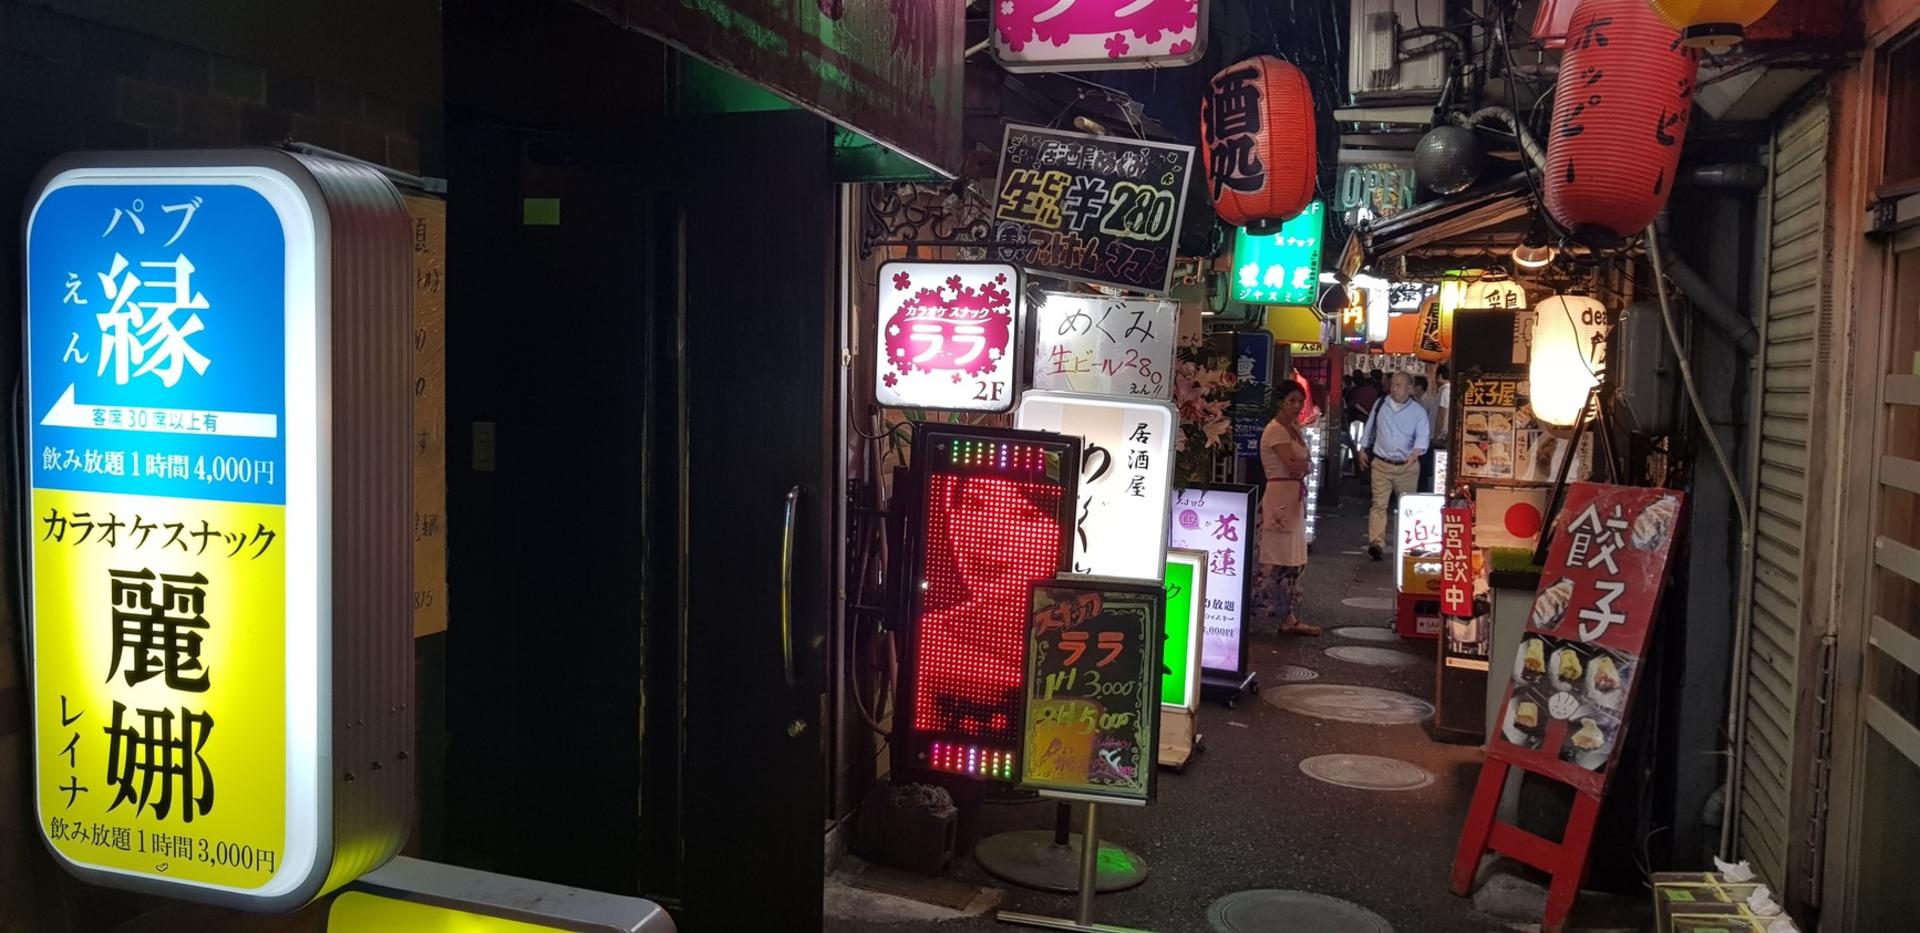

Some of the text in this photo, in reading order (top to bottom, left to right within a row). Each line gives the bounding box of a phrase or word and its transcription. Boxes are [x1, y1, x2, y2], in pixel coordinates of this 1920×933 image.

[1201, 65, 1265, 201] 酒処
[1341, 166, 1416, 209] OPEN
[102, 196, 203, 247] パブ
[62, 273, 89, 365] えん
[96, 252, 211, 388] 縁
[904, 306, 989, 321] カラオケ スナック
[1057, 302, 1155, 343] めぐみ
[908, 324, 986, 365] ララ
[972, 380, 1005, 402] 2F
[1464, 379, 1518, 407] 餃子屋
[1125, 422, 1153, 498] 居酒屋
[41, 507, 277, 560] カラオケスナック
[1209, 512, 1241, 578] 花蓮
[1442, 514, 1468, 612] 営餃中
[1567, 502, 1629, 643] 餃子
[1057, 631, 1125, 668] ララ
[102, 566, 215, 824] 麗娜
[57, 694, 89, 810] レイナ
